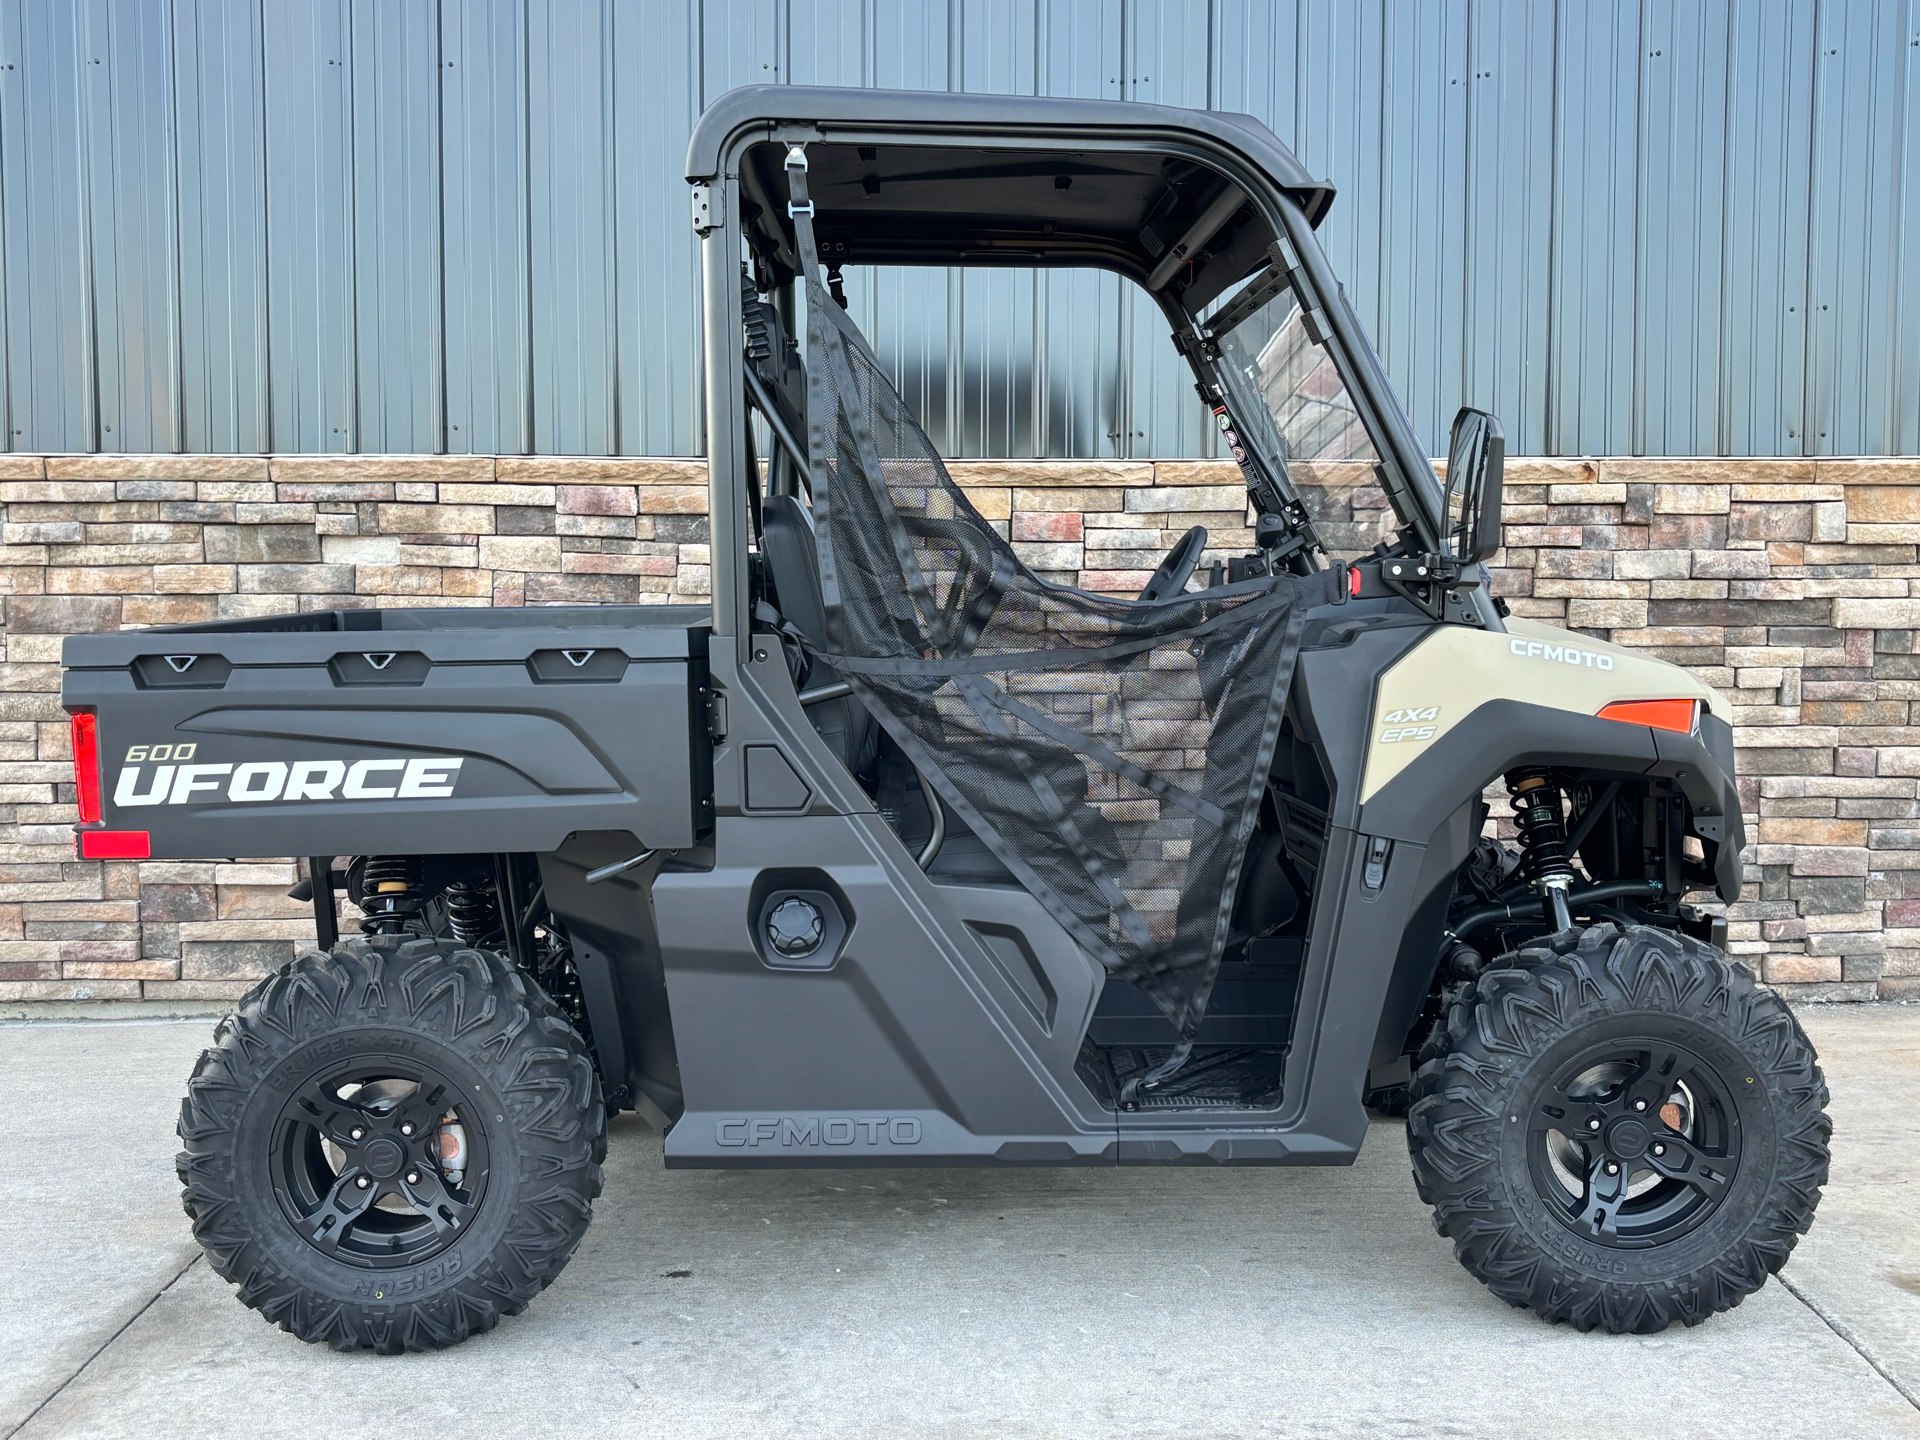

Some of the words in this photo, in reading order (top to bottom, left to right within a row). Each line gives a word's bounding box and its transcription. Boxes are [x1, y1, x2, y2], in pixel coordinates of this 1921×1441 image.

[1510, 639, 1614, 671] CFMOTO
[1383, 706, 1438, 724] 4X4
[1380, 726, 1435, 744] EPS
[125, 743, 198, 763] 600
[113, 757, 464, 807] UFORCE
[271, 1033, 360, 1090] BRUISER
[715, 1116, 922, 1147] CFMOTO
[1539, 1219, 1628, 1275] BRUISER
[351, 1247, 464, 1297] ARISUN
